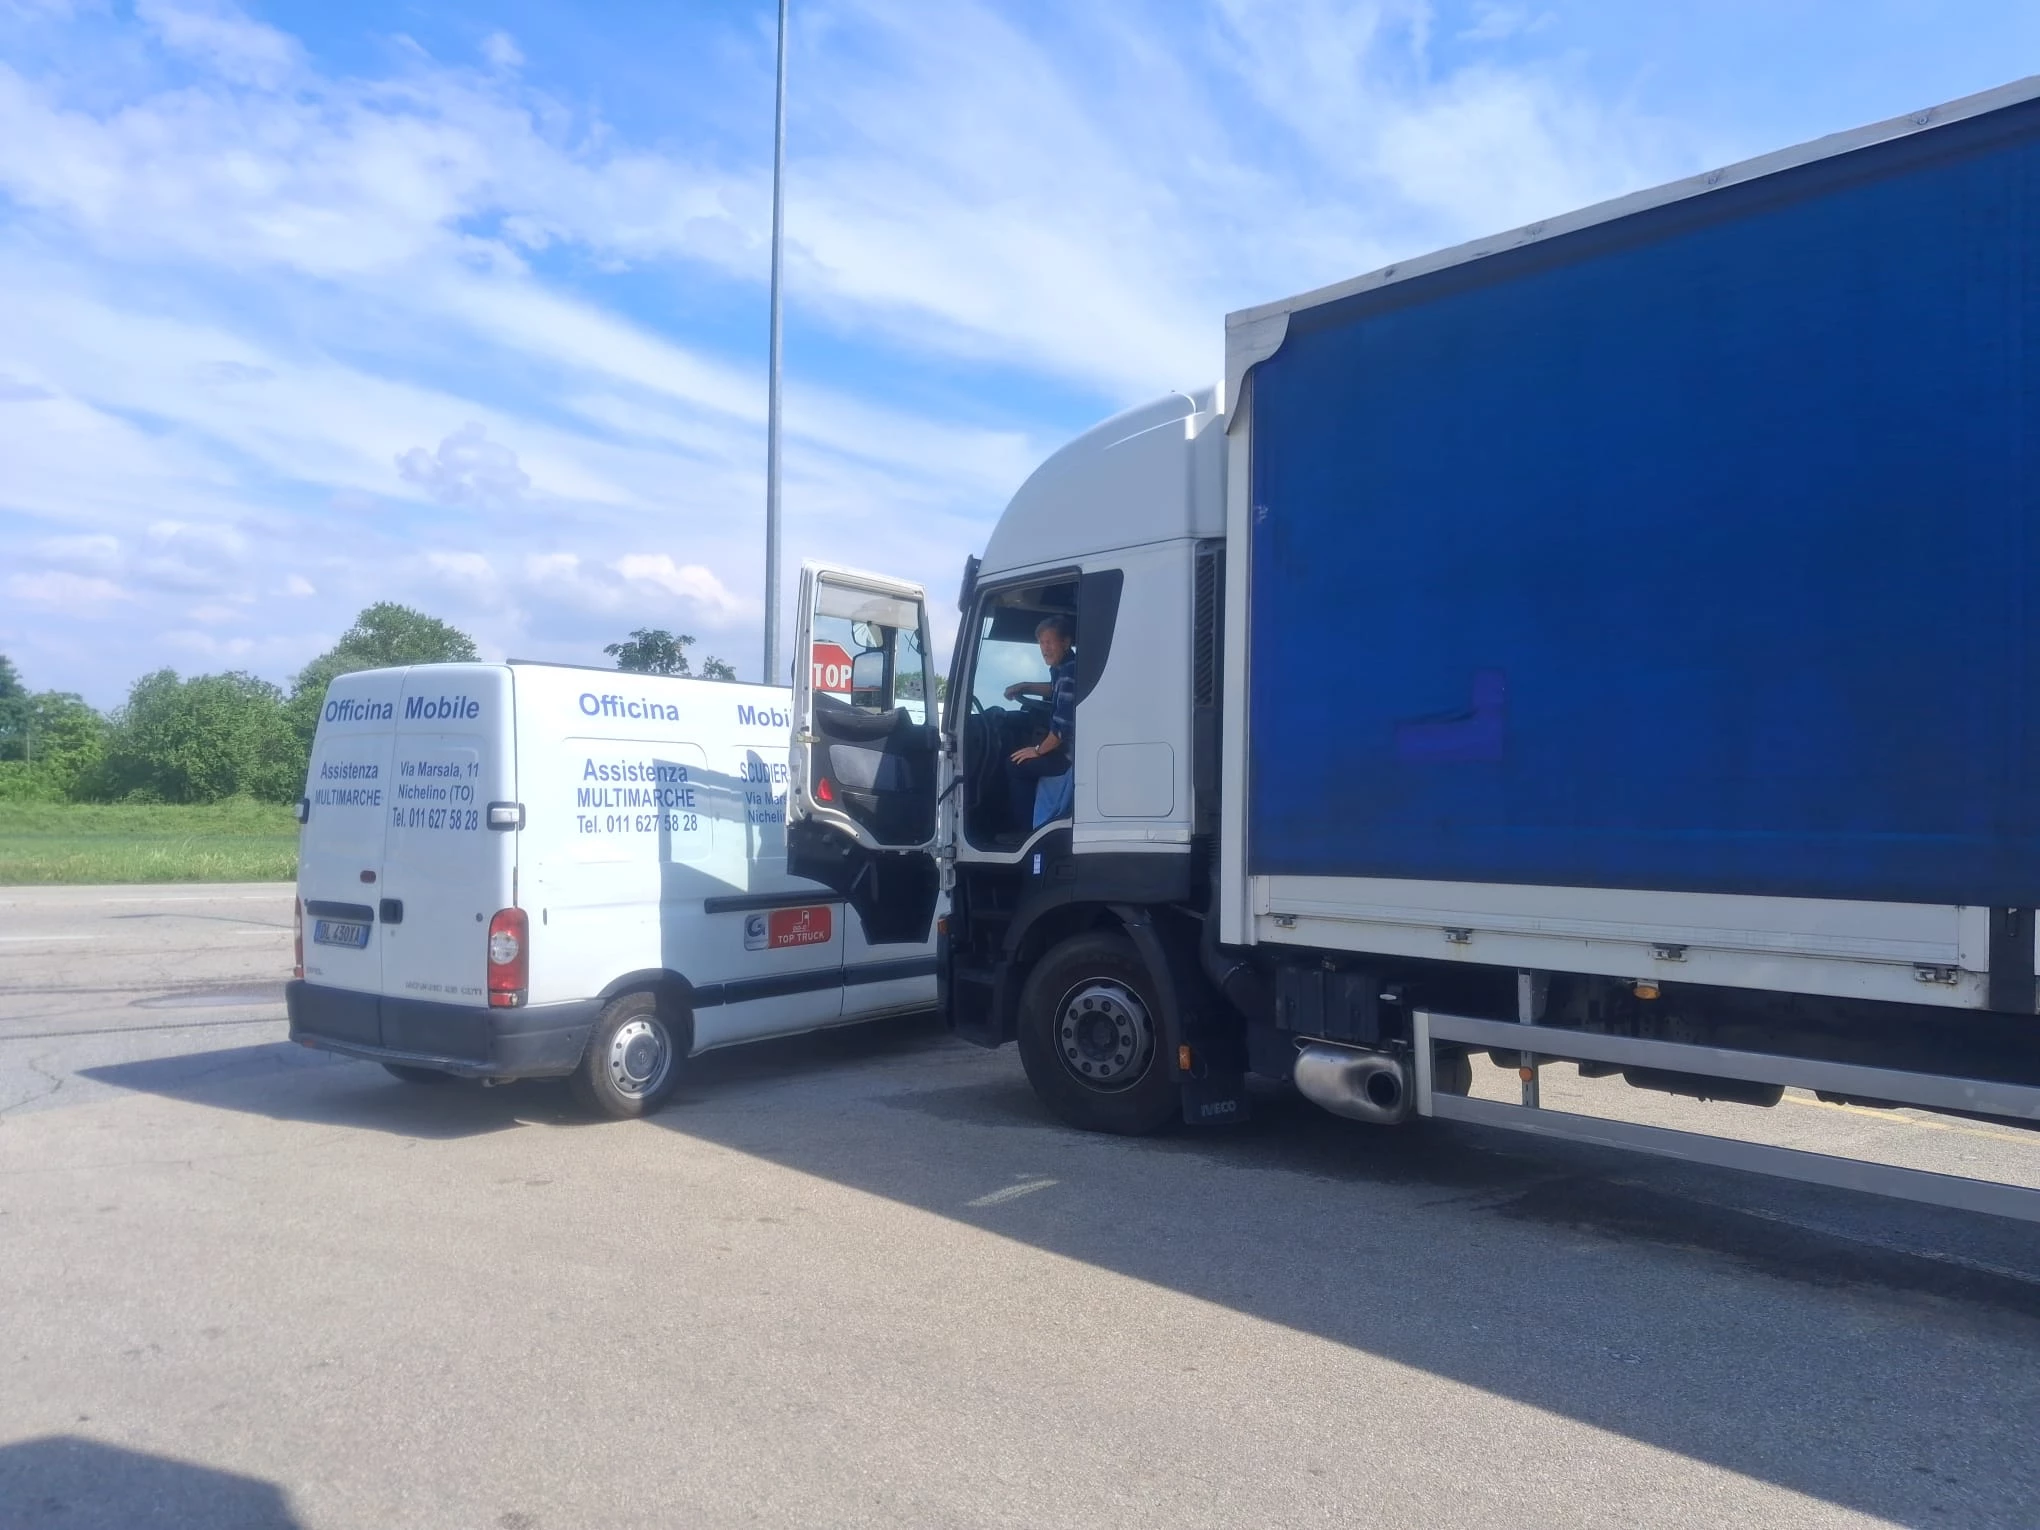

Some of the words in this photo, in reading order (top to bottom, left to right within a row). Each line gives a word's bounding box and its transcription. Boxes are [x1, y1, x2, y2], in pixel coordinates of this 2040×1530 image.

[813, 663, 852, 689] TOP
[325, 699, 393, 722] Officina
[404, 696, 480, 720] Mobile
[579, 692, 680, 721] Officina
[737, 704, 791, 728] Mobi
[320, 761, 379, 780] Assistenza
[400, 761, 415, 777] Via
[417, 761, 463, 780] Marsala,
[467, 762, 479, 778] 11
[583, 758, 688, 783] Assistenza
[315, 788, 381, 807] MULTIMARCHE
[398, 783, 446, 801] Nichelino
[450, 784, 474, 806] (TO)
[577, 787, 696, 807] MULTIMARCHE
[745, 791, 762, 805] Via
[392, 806, 406, 828] Tel.
[409, 807, 425, 829] 011
[428, 808, 447, 830] 627
[449, 809, 462, 831] 58
[464, 810, 479, 832] 28
[577, 815, 602, 834] Tel.
[606, 814, 630, 833] 011
[635, 814, 660, 833] 627
[664, 814, 680, 832] 58
[682, 814, 698, 832] 28
[778, 934, 794, 944] TOP
[797, 931, 825, 942] TRUCK
[1200, 1100, 1237, 1117] IVECO
